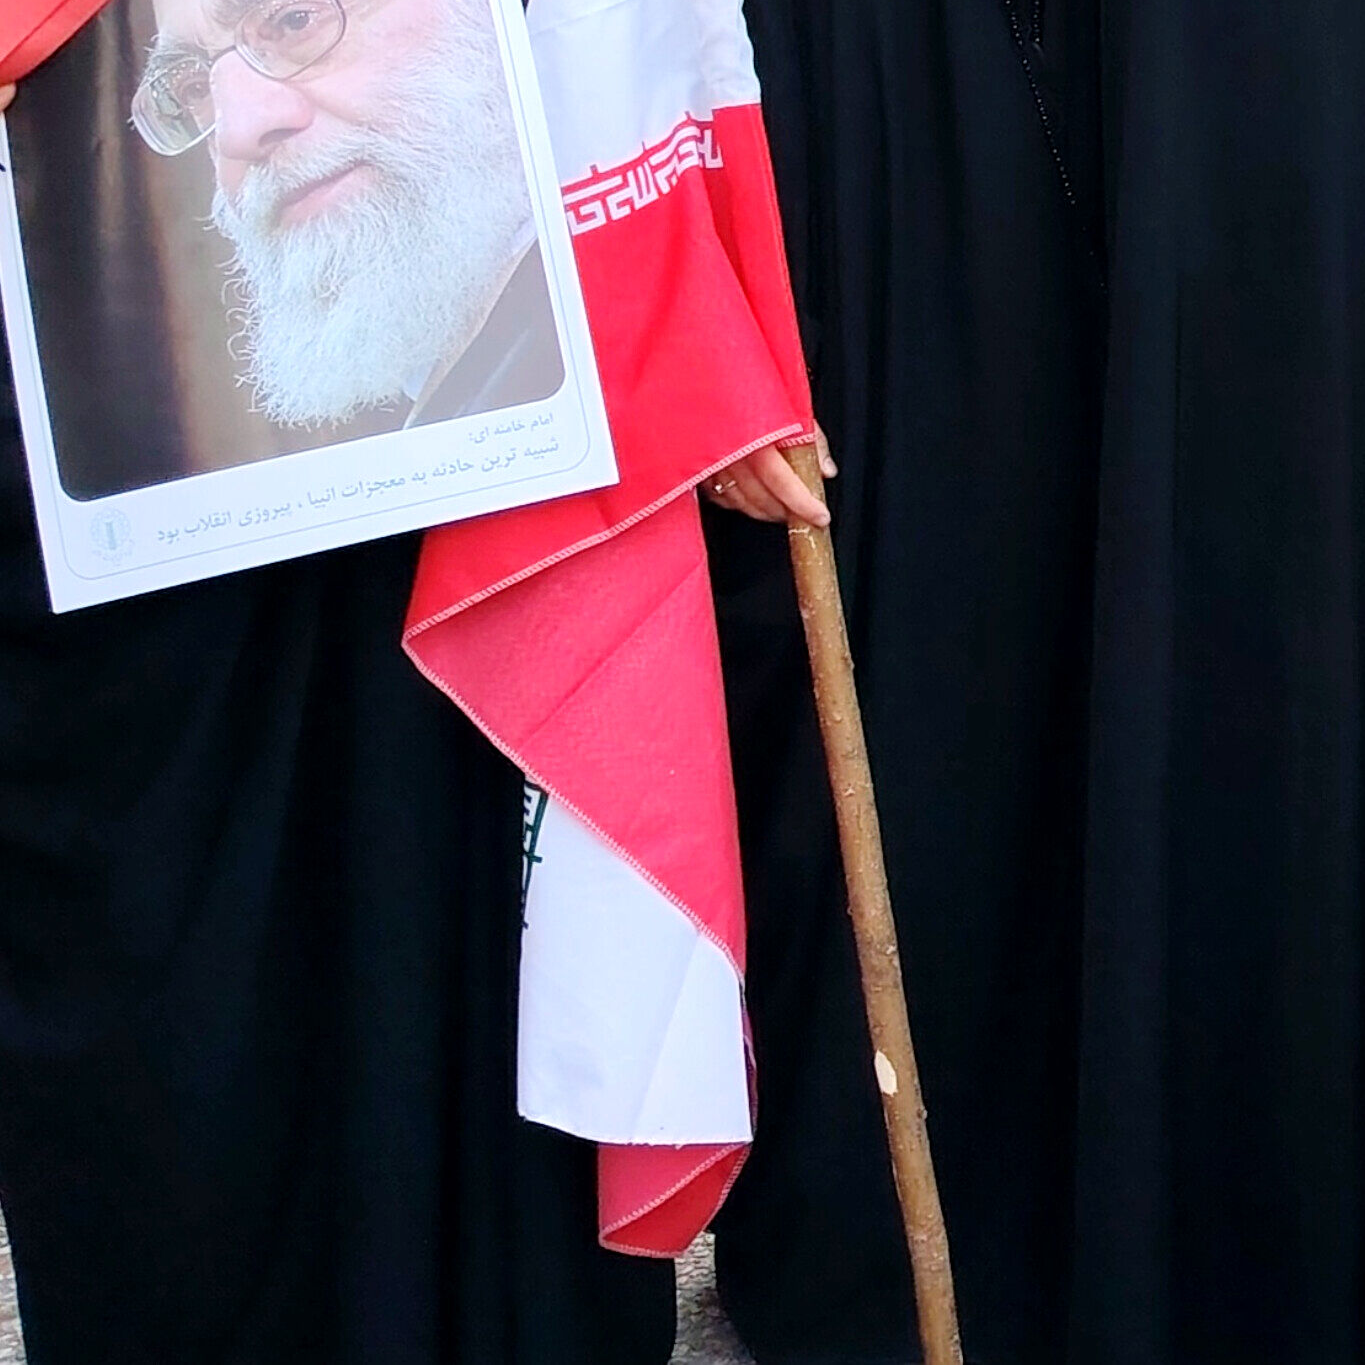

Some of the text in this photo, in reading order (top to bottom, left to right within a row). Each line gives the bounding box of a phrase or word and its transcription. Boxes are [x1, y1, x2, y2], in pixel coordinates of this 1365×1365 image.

[468, 412, 554, 444] امام خامنه ای:
[523, 437, 559, 460] شبیه
[432, 458, 475, 478] حادثه
[481, 447, 517, 473] ترین
[341, 477, 406, 499] معجزات
[411, 471, 427, 485] به
[307, 487, 337, 509] انبیا
[184, 511, 232, 538] انقلاب
[238, 501, 292, 528] پیروزی
[157, 528, 179, 545] بود
